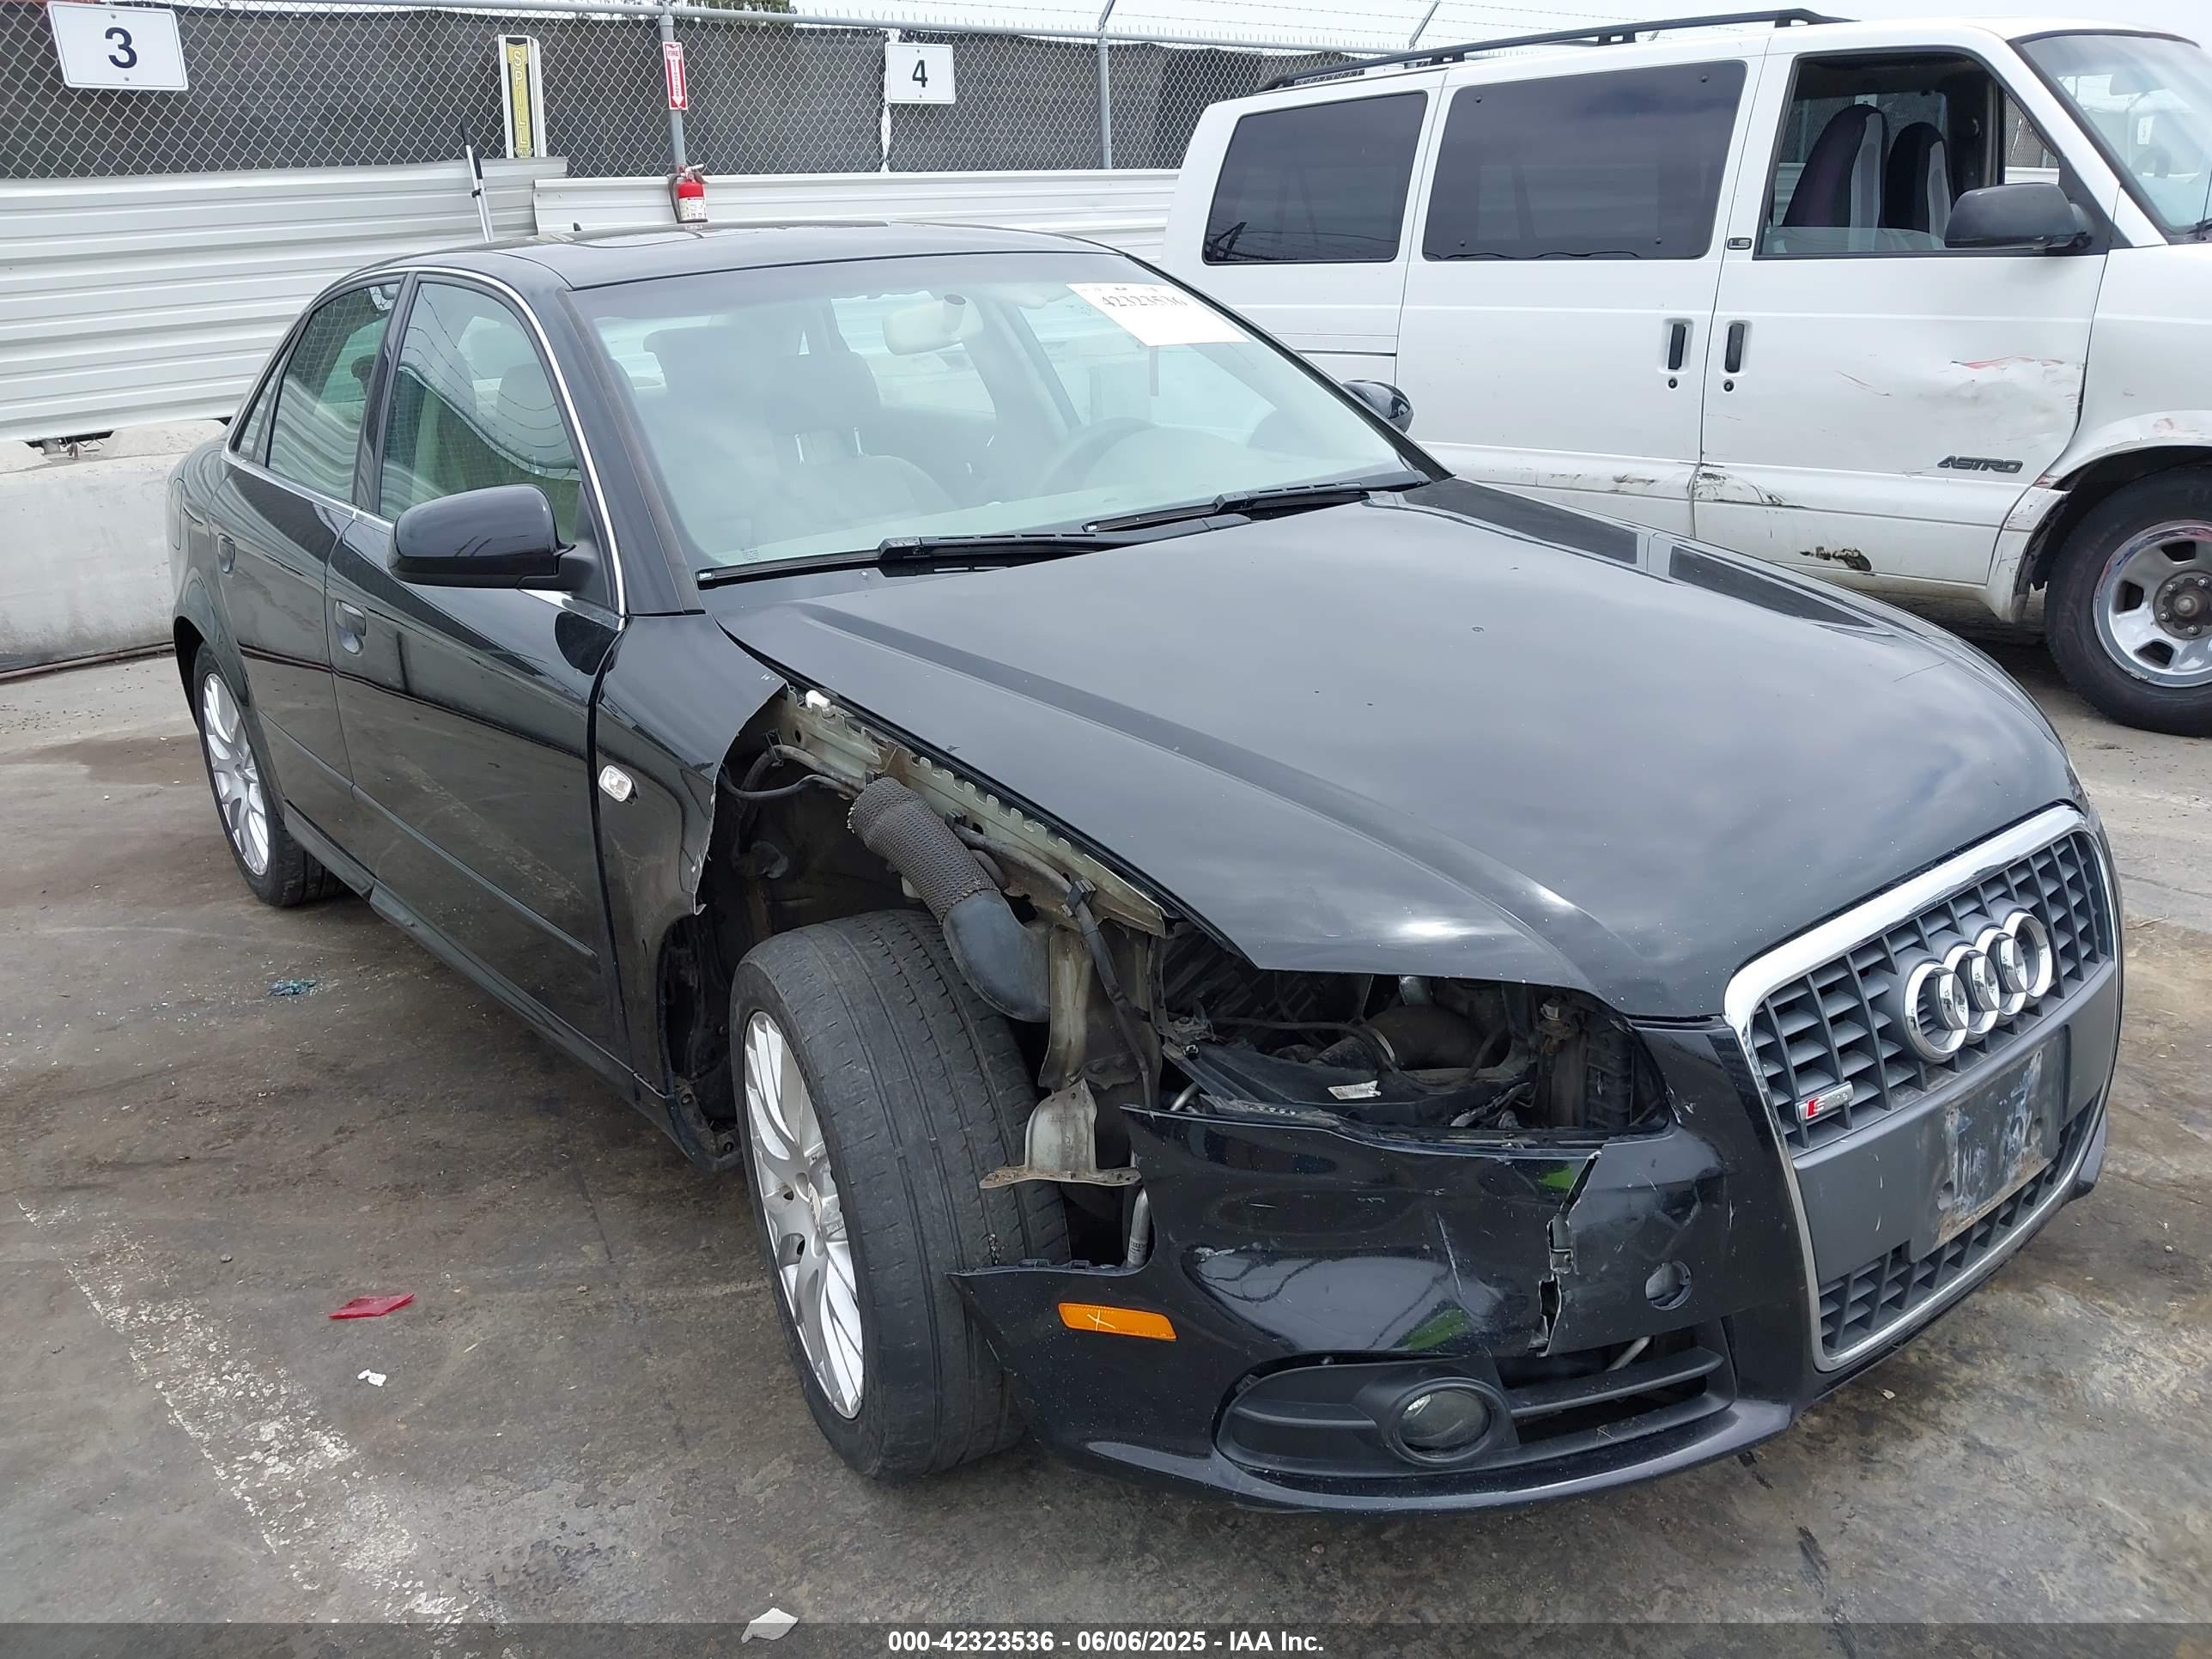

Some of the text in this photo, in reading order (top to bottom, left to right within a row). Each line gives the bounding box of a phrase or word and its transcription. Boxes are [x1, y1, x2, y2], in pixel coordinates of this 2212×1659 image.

[105, 27, 137, 69] 3
[912, 59, 928, 88] 4
[513, 51, 527, 144] SPILL
[1728, 240, 1750, 249] LS
[1937, 455, 2023, 474] ASTRO
